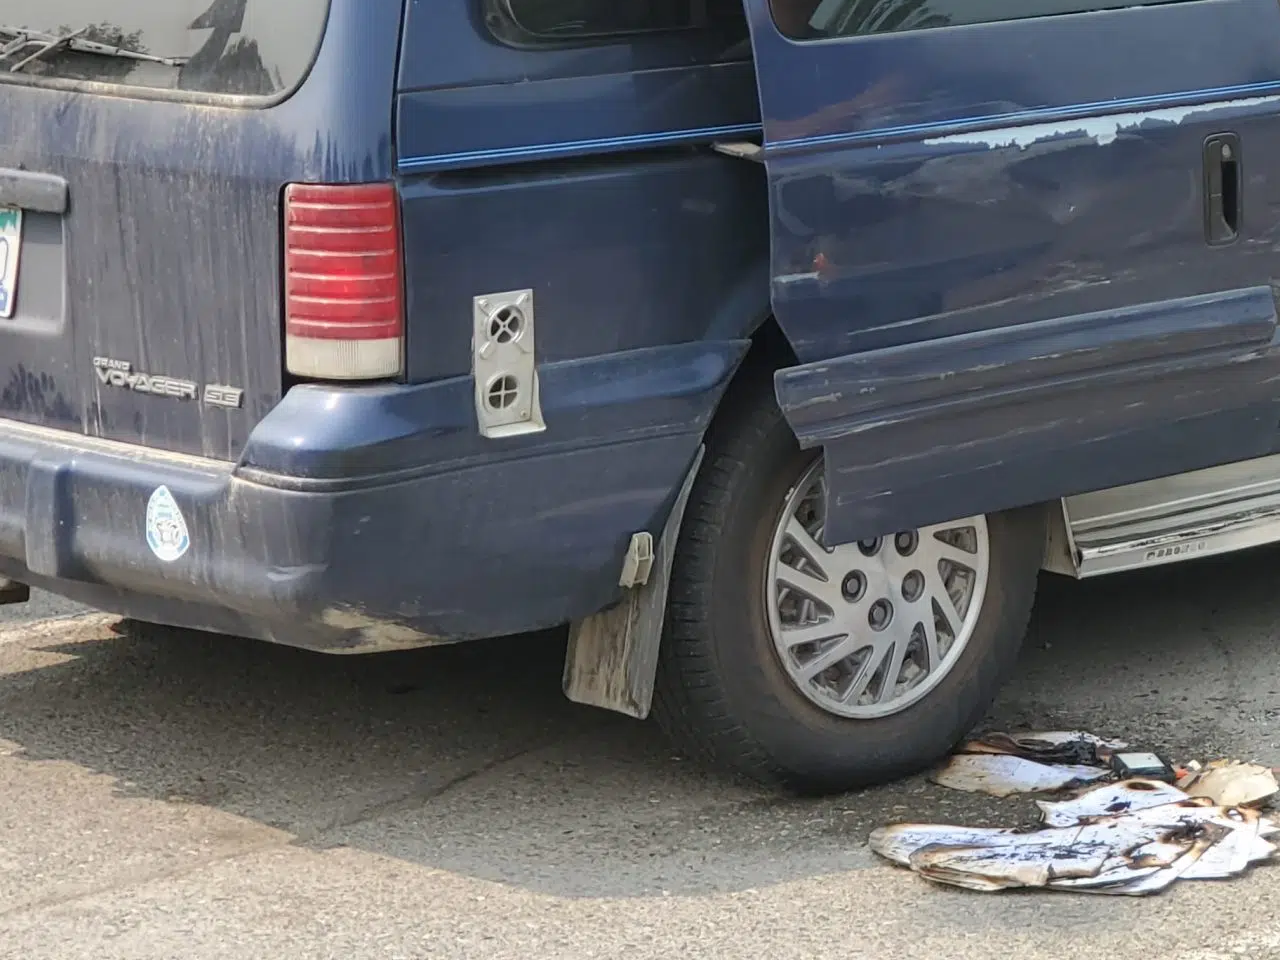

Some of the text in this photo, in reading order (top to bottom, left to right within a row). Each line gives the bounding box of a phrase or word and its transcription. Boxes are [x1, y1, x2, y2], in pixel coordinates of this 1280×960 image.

[93, 356, 131, 371] GRAND
[95, 367, 241, 407] VOYAGER SE
